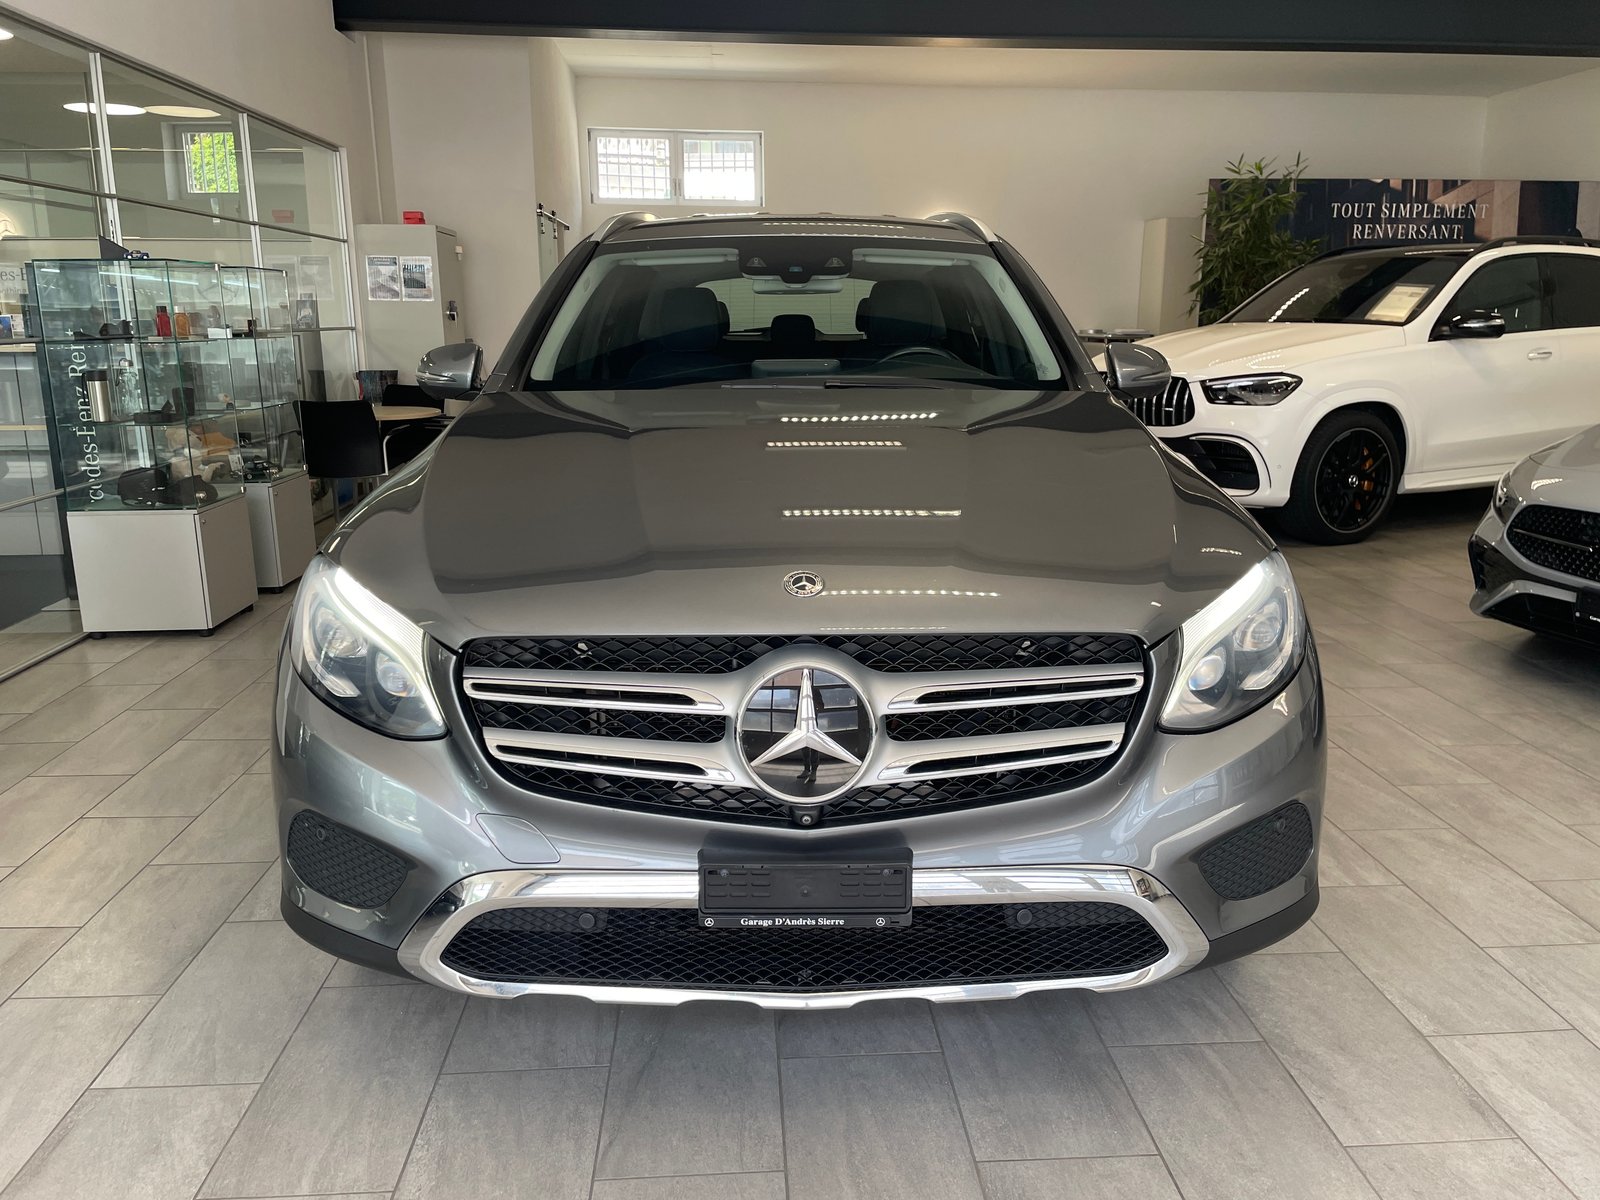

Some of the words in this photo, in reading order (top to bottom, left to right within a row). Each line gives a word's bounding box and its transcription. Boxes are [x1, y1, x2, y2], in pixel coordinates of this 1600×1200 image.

[1331, 202, 1376, 218] TOUT
[1380, 202, 1489, 219] SIMPLEMENT
[1352, 223, 1464, 240] RENVERSANT.
[740, 917, 773, 927] Garage
[775, 917, 816, 926] D'Andrès
[817, 917, 845, 926] Sierre
